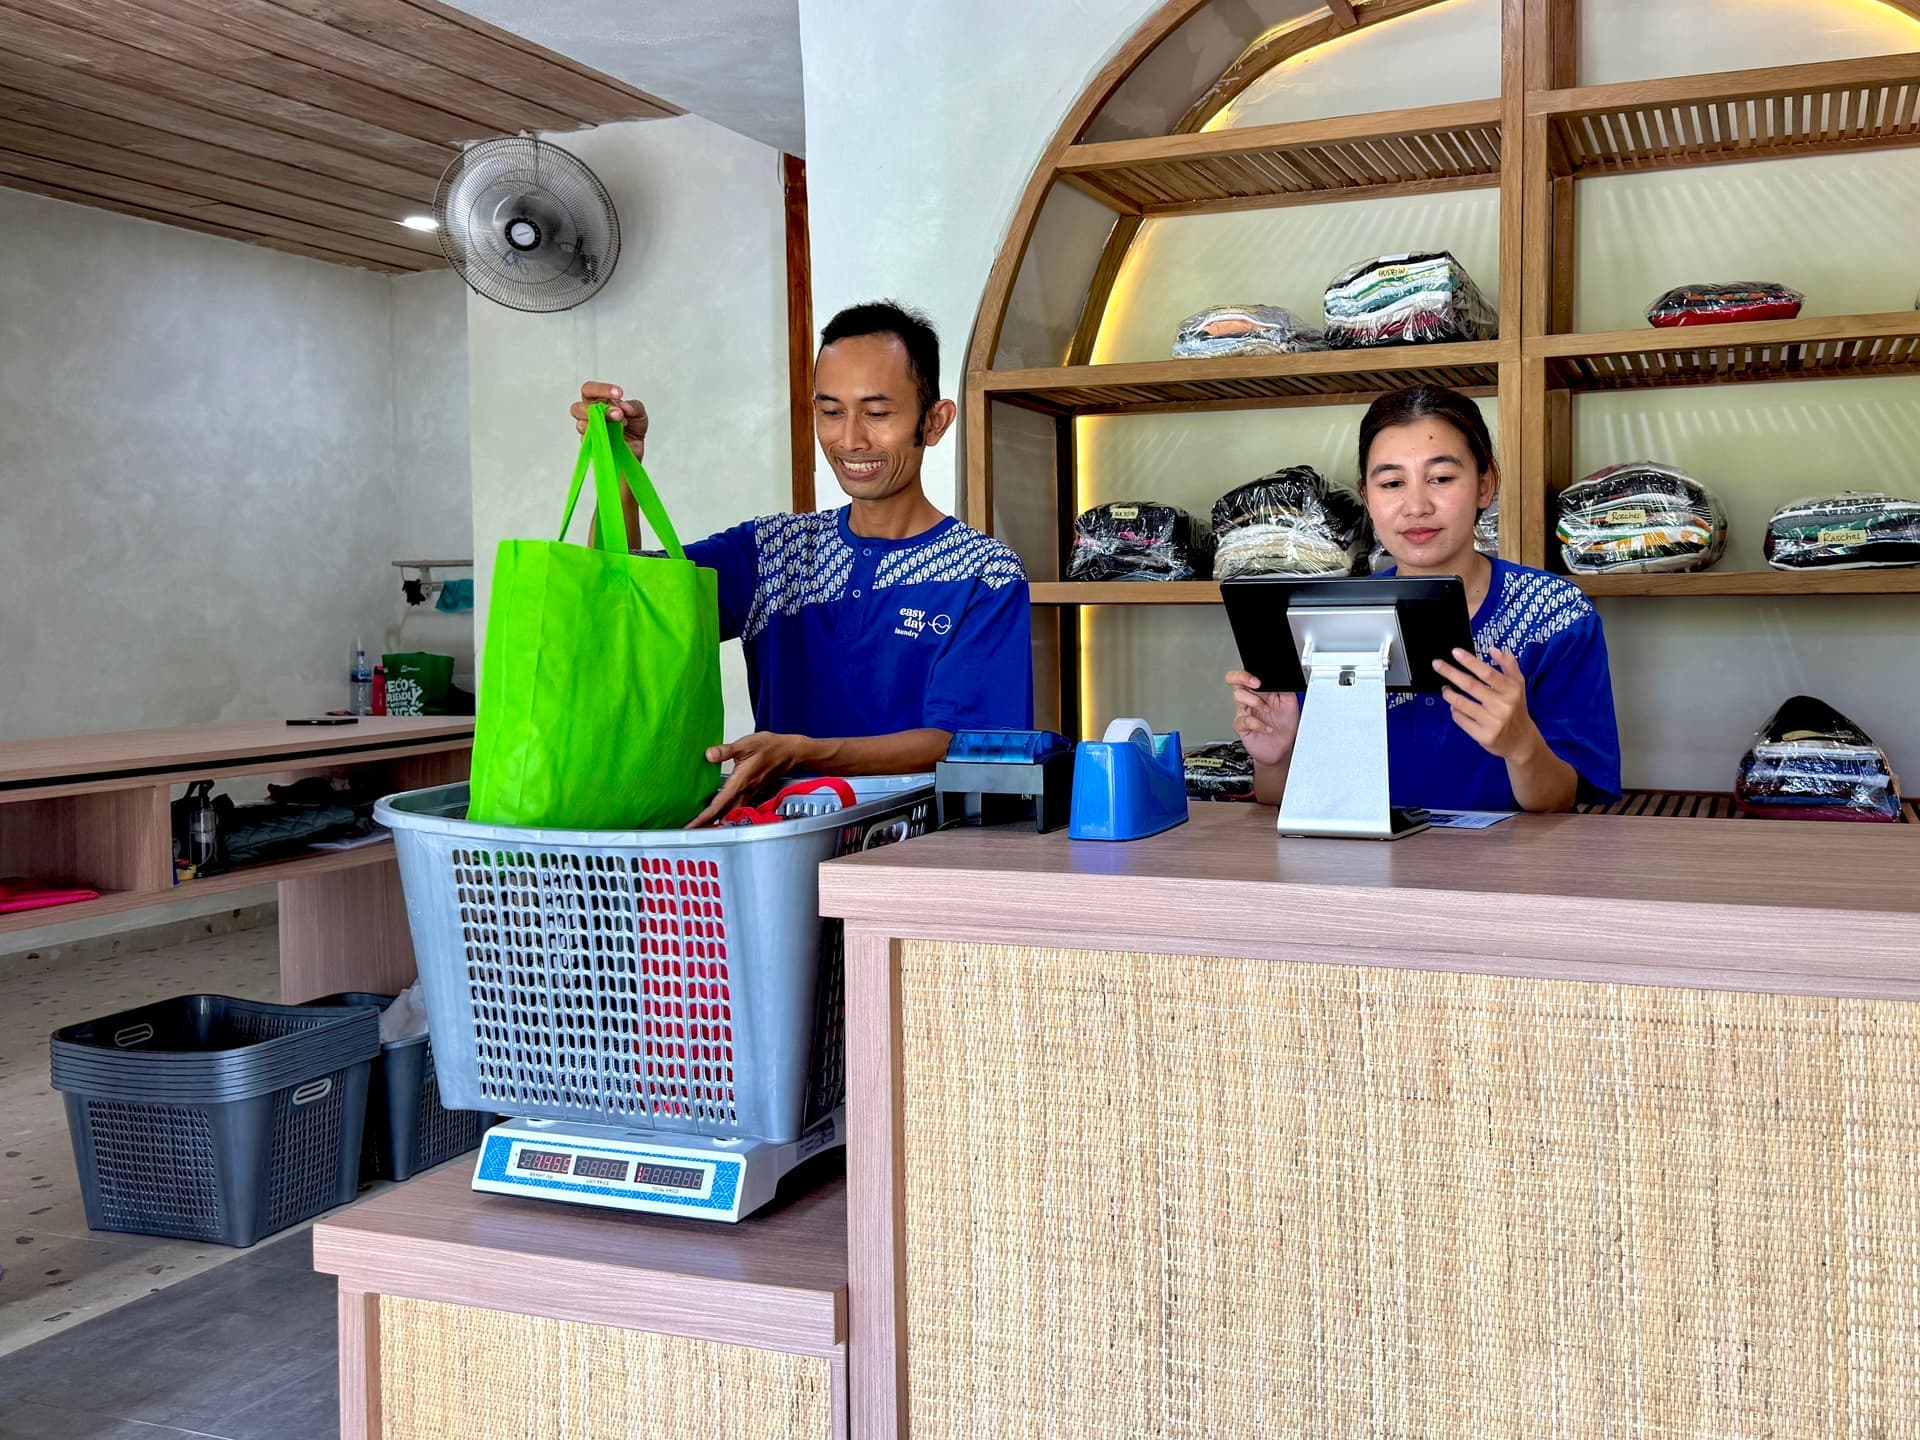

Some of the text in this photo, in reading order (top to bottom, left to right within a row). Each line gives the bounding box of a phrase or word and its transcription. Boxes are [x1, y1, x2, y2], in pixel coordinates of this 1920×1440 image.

[899, 607, 926, 620] easy
[903, 616, 926, 632] day
[894, 626, 920, 640] laundry
